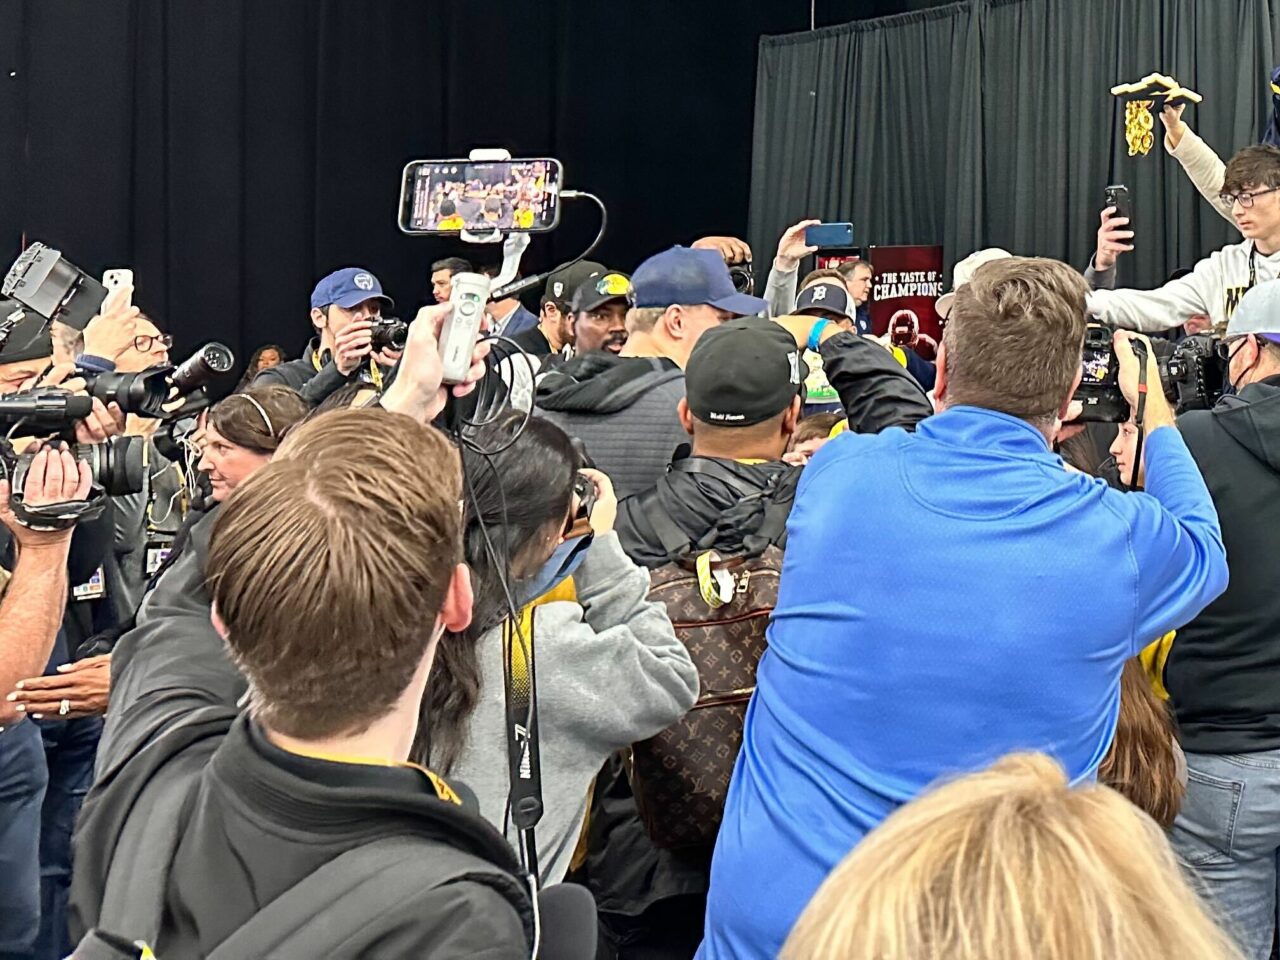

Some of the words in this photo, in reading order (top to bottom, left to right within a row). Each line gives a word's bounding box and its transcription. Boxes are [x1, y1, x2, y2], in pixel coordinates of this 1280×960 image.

[882, 272, 898, 284] THE
[899, 271, 926, 283] TASTE
[927, 271, 937, 282] OF
[873, 282, 943, 301] CHAMPIONS
